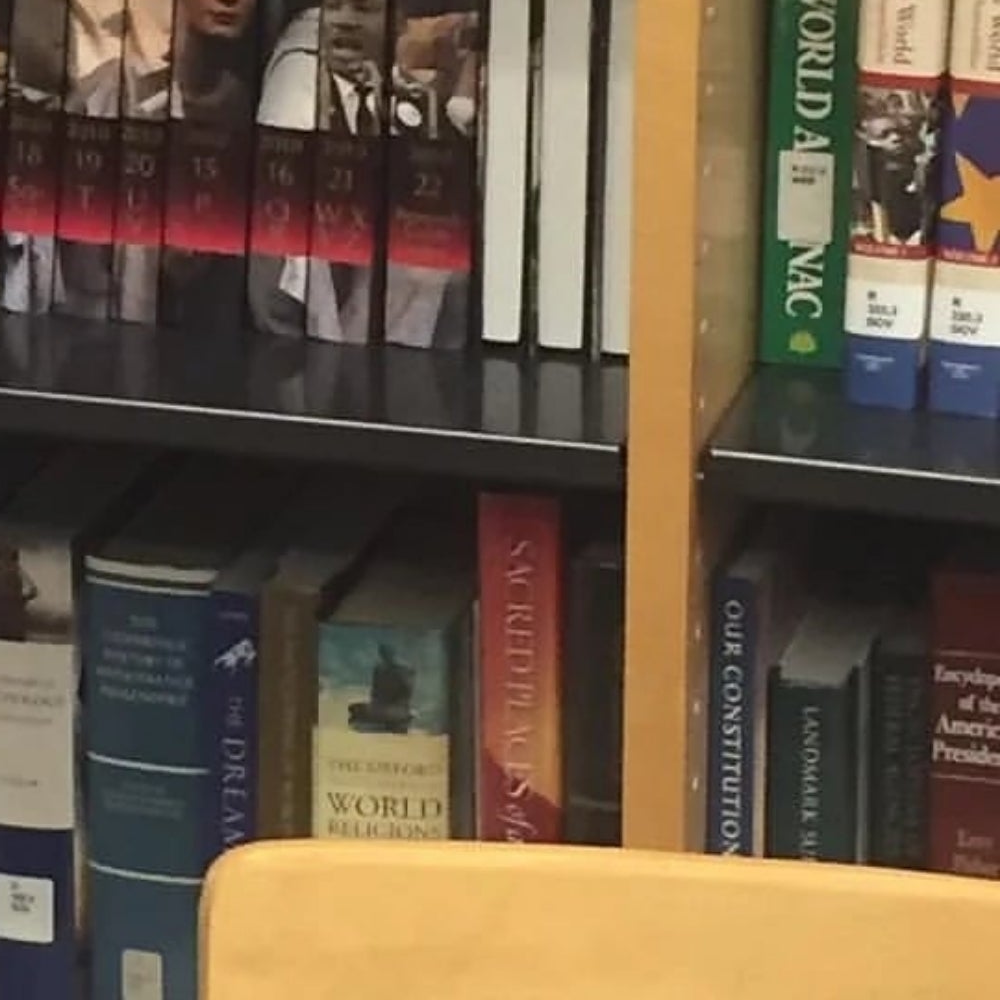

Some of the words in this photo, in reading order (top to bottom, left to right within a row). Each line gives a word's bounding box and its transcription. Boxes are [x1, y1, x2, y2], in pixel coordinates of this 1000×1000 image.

[893, 4, 921, 66] World
[785, 125, 832, 320] ANAC
[503, 540, 536, 675] SACRED
[722, 600, 746, 656] OUR
[503, 681, 535, 798] PLACES
[957, 693, 976, 712] of
[720, 664, 744, 856] CONSTITUTION
[326, 791, 443, 821] WORLD
